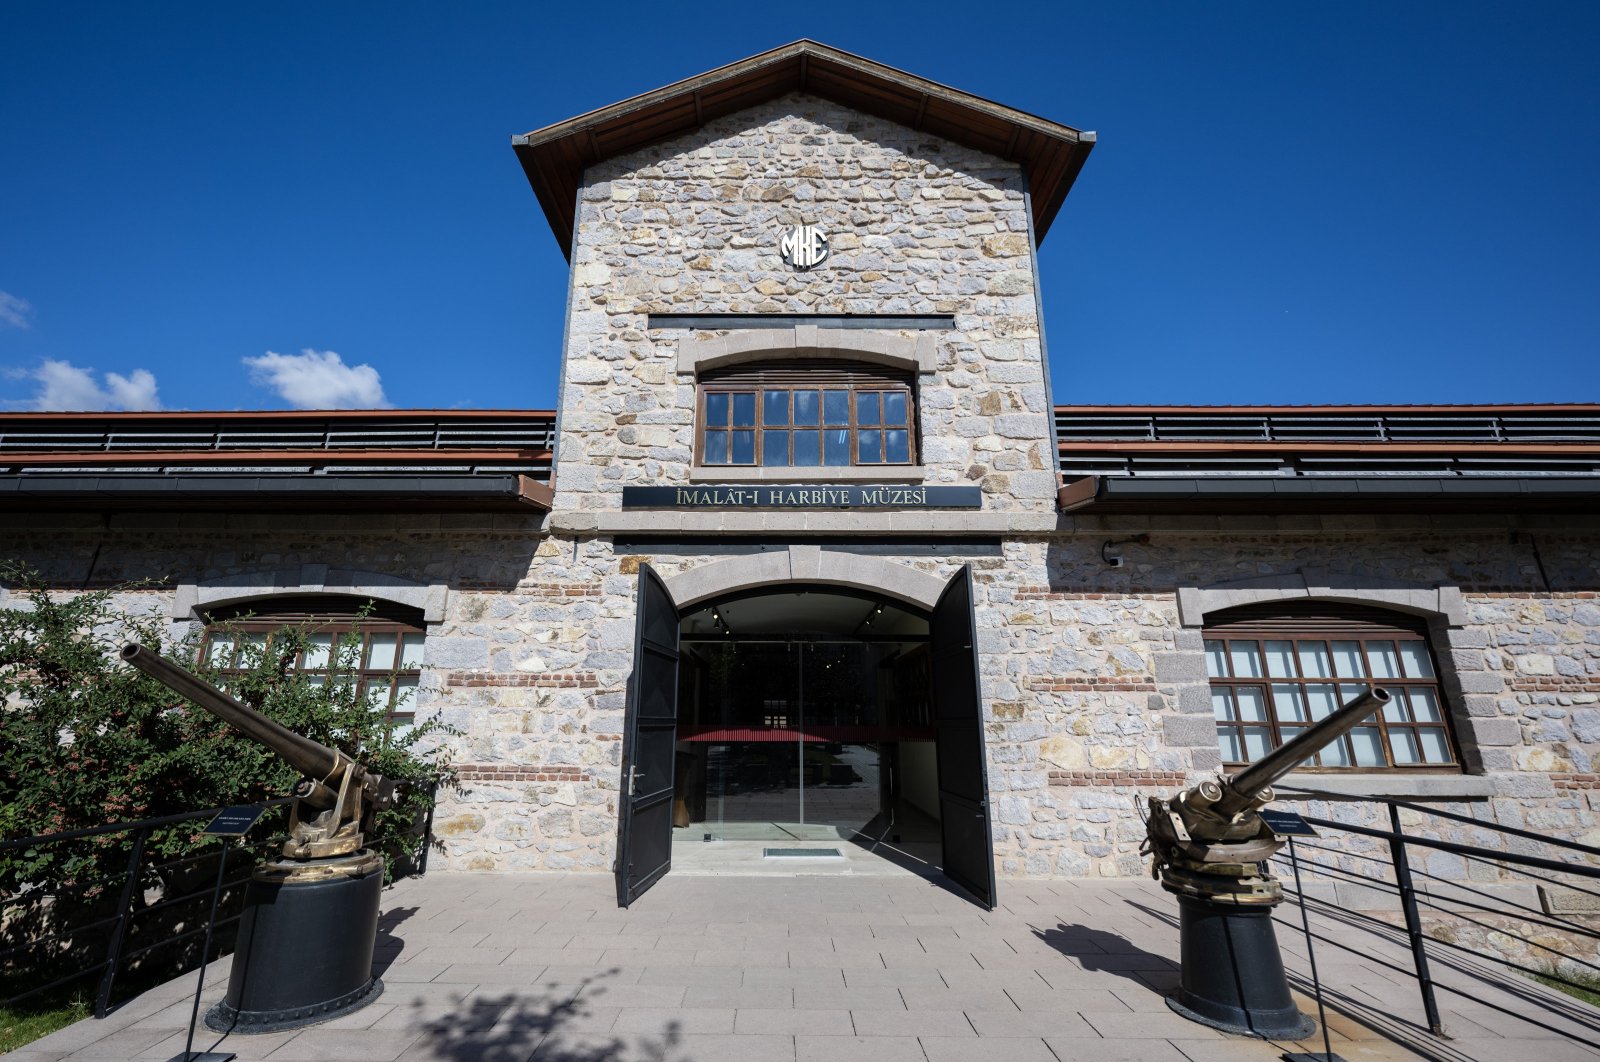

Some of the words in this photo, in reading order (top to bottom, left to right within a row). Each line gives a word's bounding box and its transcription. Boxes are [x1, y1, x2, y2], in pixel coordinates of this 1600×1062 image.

[781, 225, 828, 266] MKE
[676, 488, 759, 505] İMALÂT-I
[769, 488, 850, 505] HARBİYE
[861, 487, 927, 505] MÜZESİ
